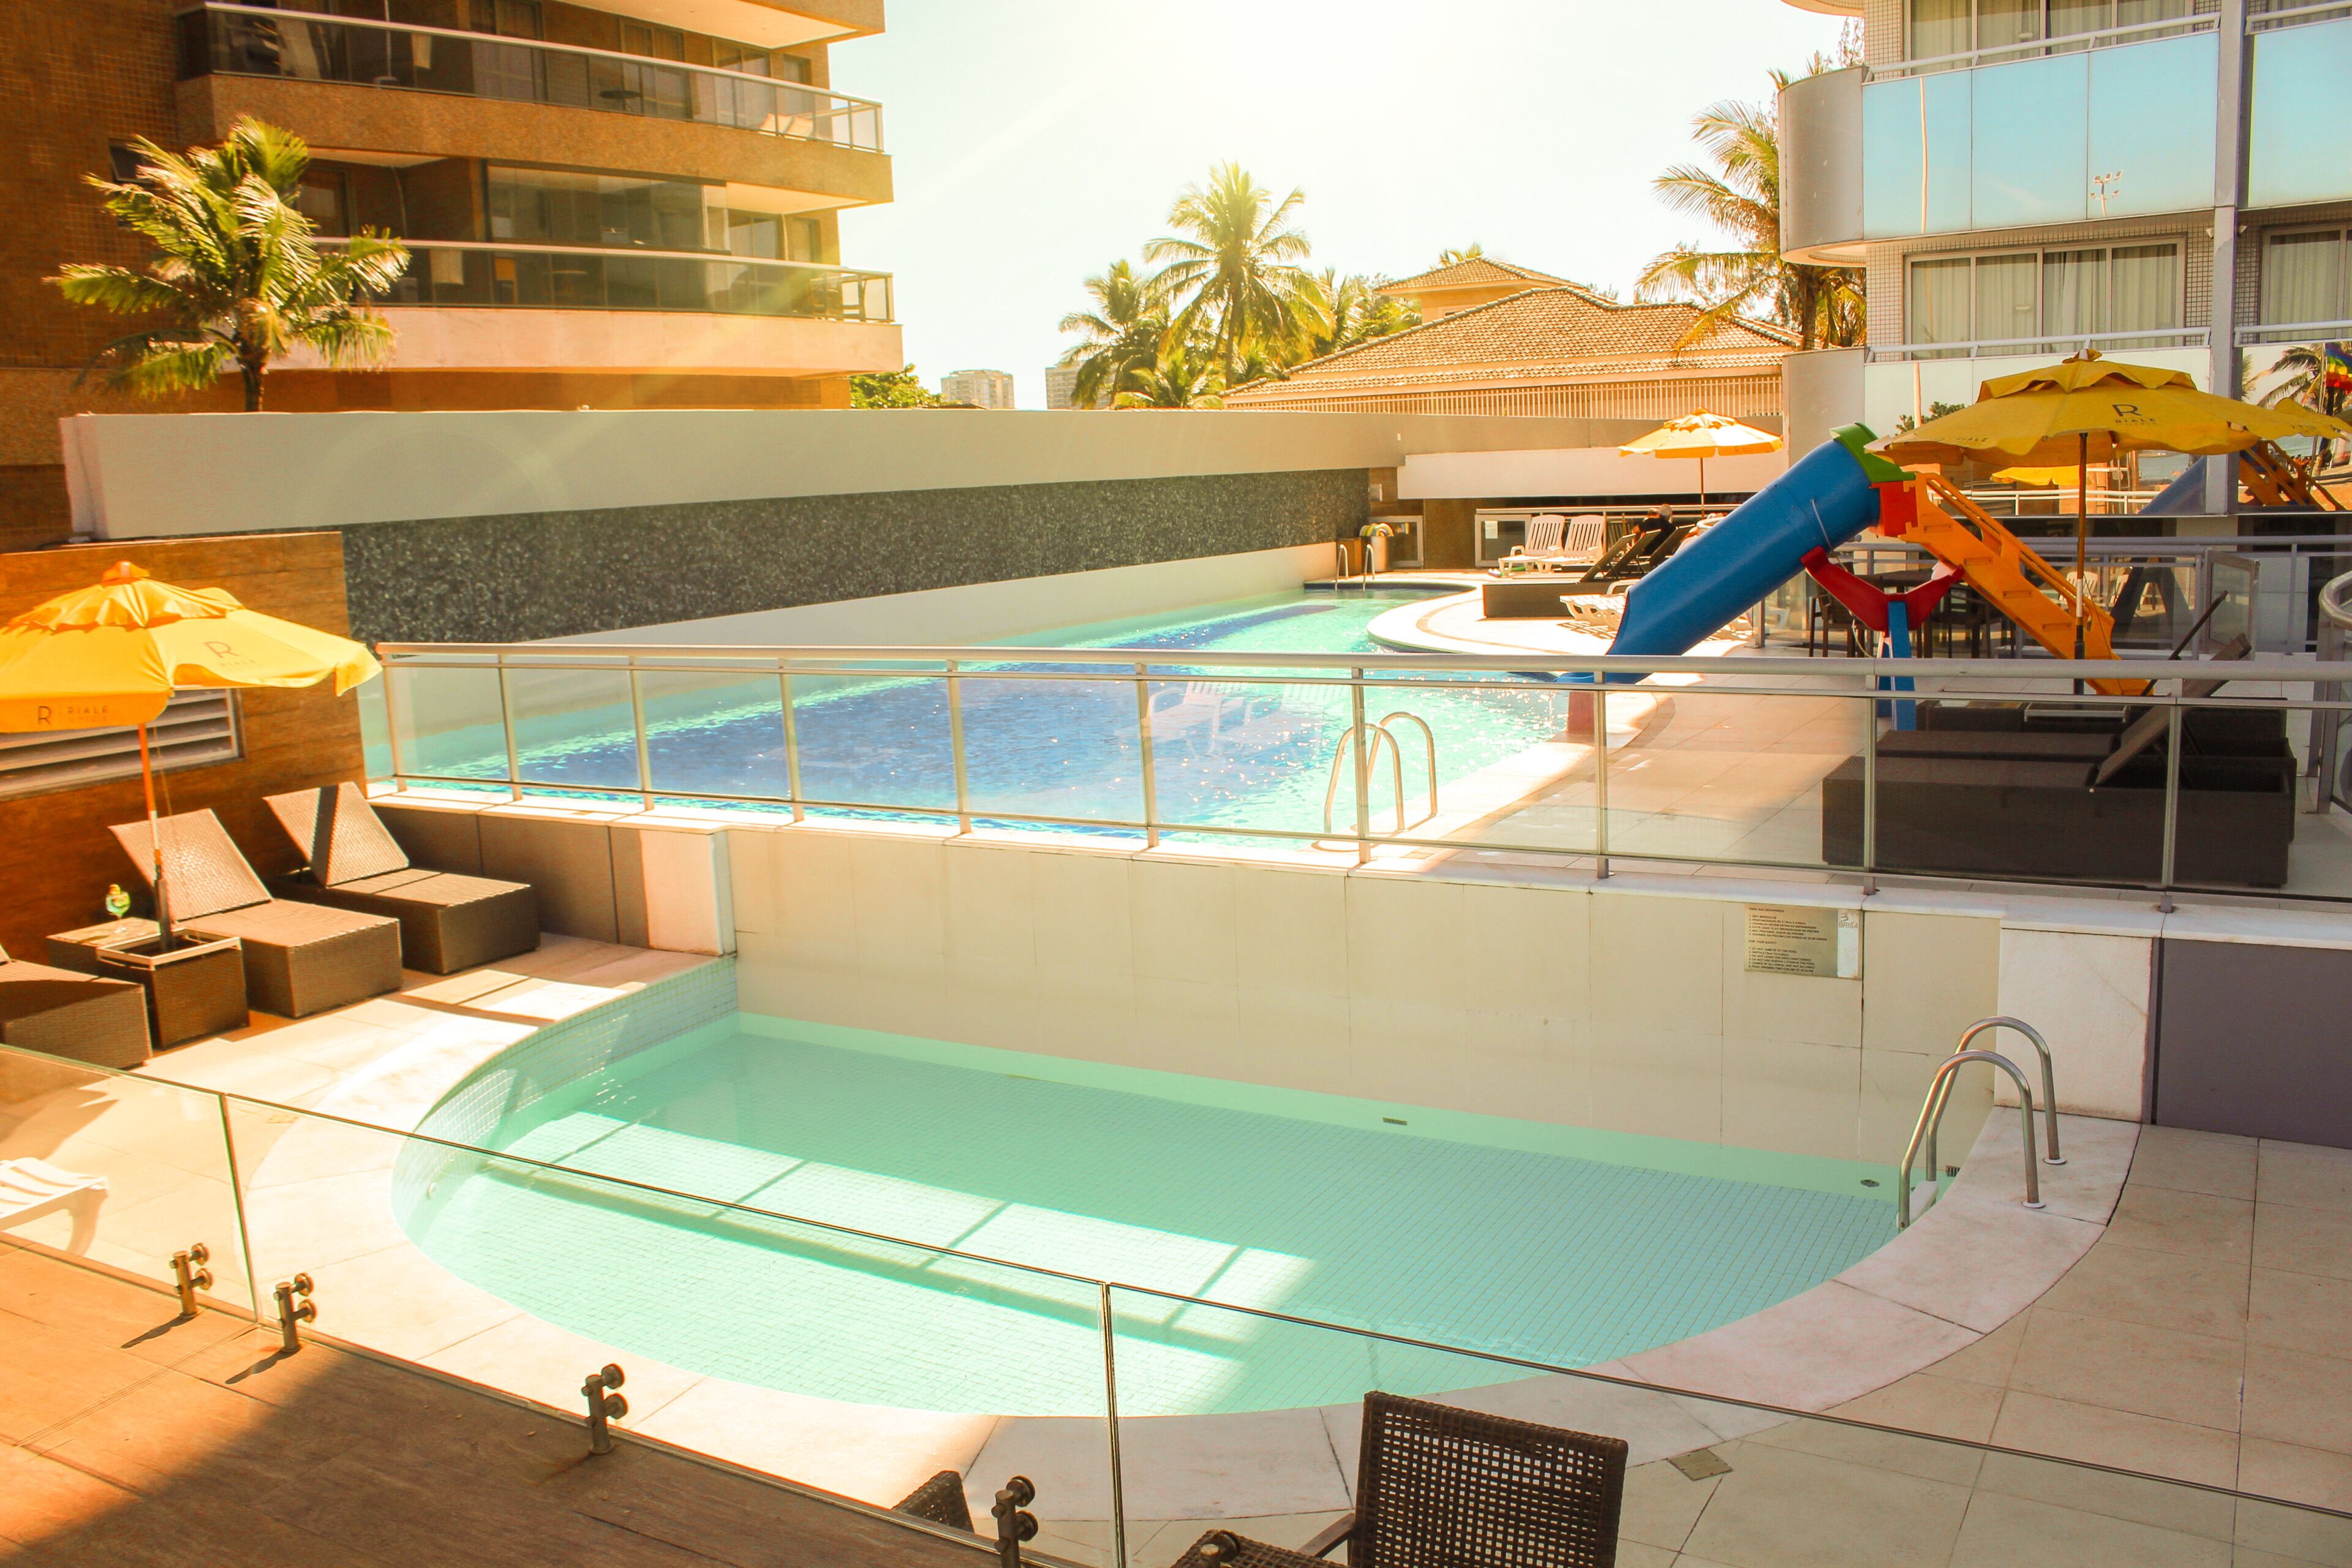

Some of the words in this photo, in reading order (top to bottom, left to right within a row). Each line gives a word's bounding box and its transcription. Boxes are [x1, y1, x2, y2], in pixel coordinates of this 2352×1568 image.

[2112, 404, 2143, 417] R
[203, 641, 240, 658] R
[37, 706, 53, 725] R
[68, 706, 108, 714] RIALE
